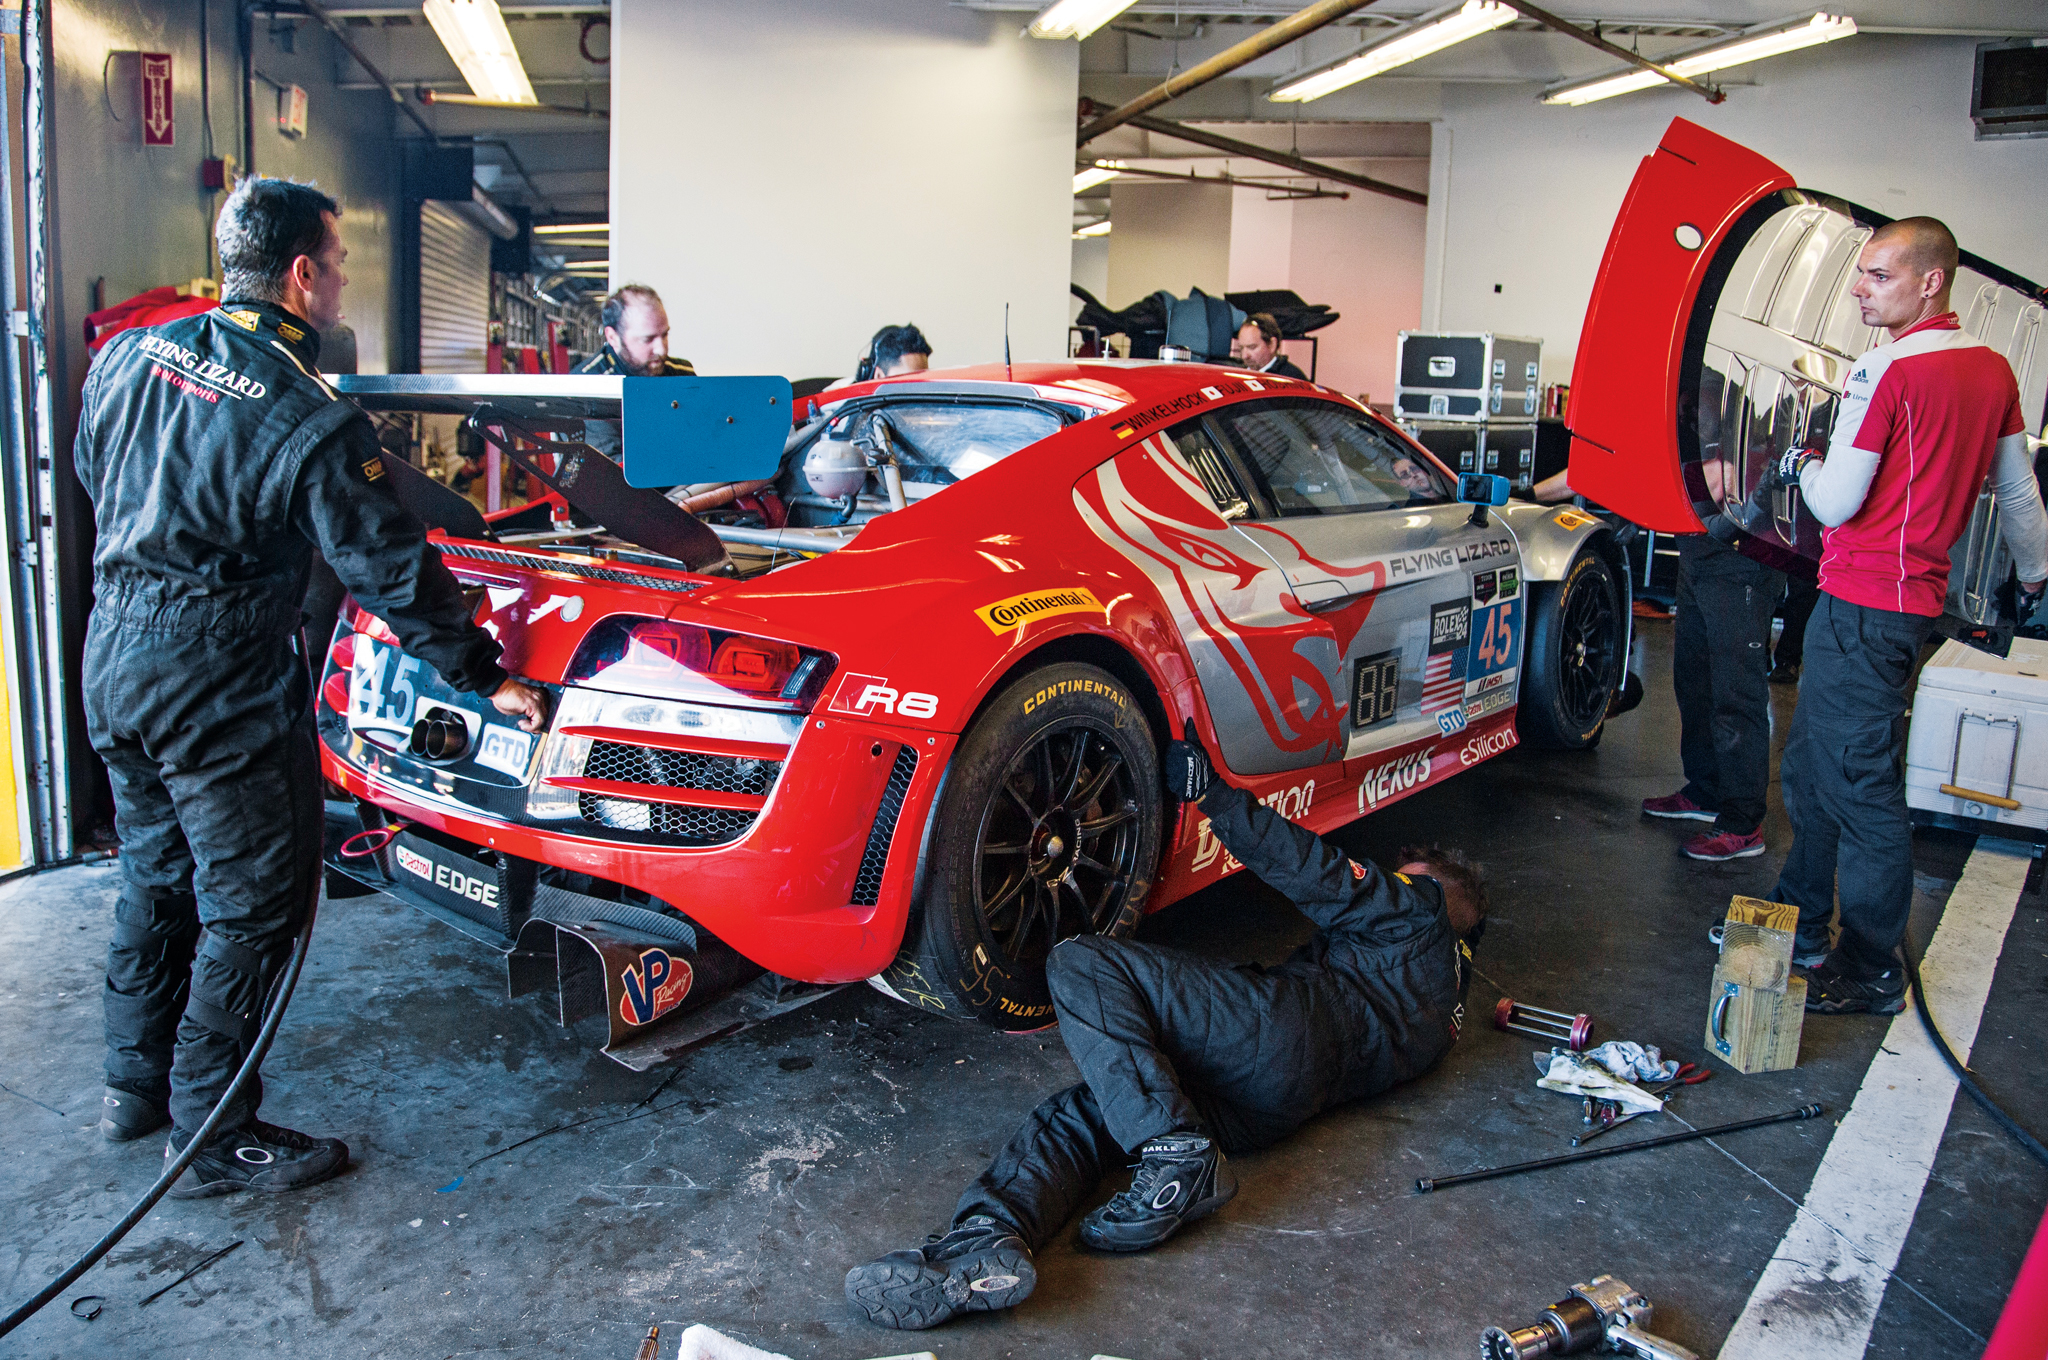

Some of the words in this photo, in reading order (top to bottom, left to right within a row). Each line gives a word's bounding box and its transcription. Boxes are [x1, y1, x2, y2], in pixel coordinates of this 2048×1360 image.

[139, 336, 199, 369] FLYING
[195, 360, 267, 399] LIZARD
[1215, 379, 1248, 395] FUJII
[1124, 392, 1208, 430] WINKELHOCK
[1390, 549, 1454, 577] FLYING
[1455, 539, 1511, 564] LIZARD
[989, 591, 1086, 627] Continental
[1433, 613, 1461, 637] ROLEX
[1478, 603, 1511, 670] 45
[355, 646, 421, 726] 45
[854, 684, 939, 719] R8
[1023, 679, 1125, 715] CONTINENTAL
[1484, 690, 1511, 711] EDGE
[1437, 709, 1465, 733] GTD
[484, 733, 526, 768] GTD
[1460, 728, 1517, 766] eSilicon
[1358, 744, 1438, 815] NEXUS
[405, 852, 430, 877] Castrol
[435, 864, 500, 909] EDGE
[621, 948, 672, 1025] VP
[656, 970, 692, 1011] Racing
[1000, 997, 1054, 1017] NENTAL
[1142, 1145, 1178, 1153] OAKLE
